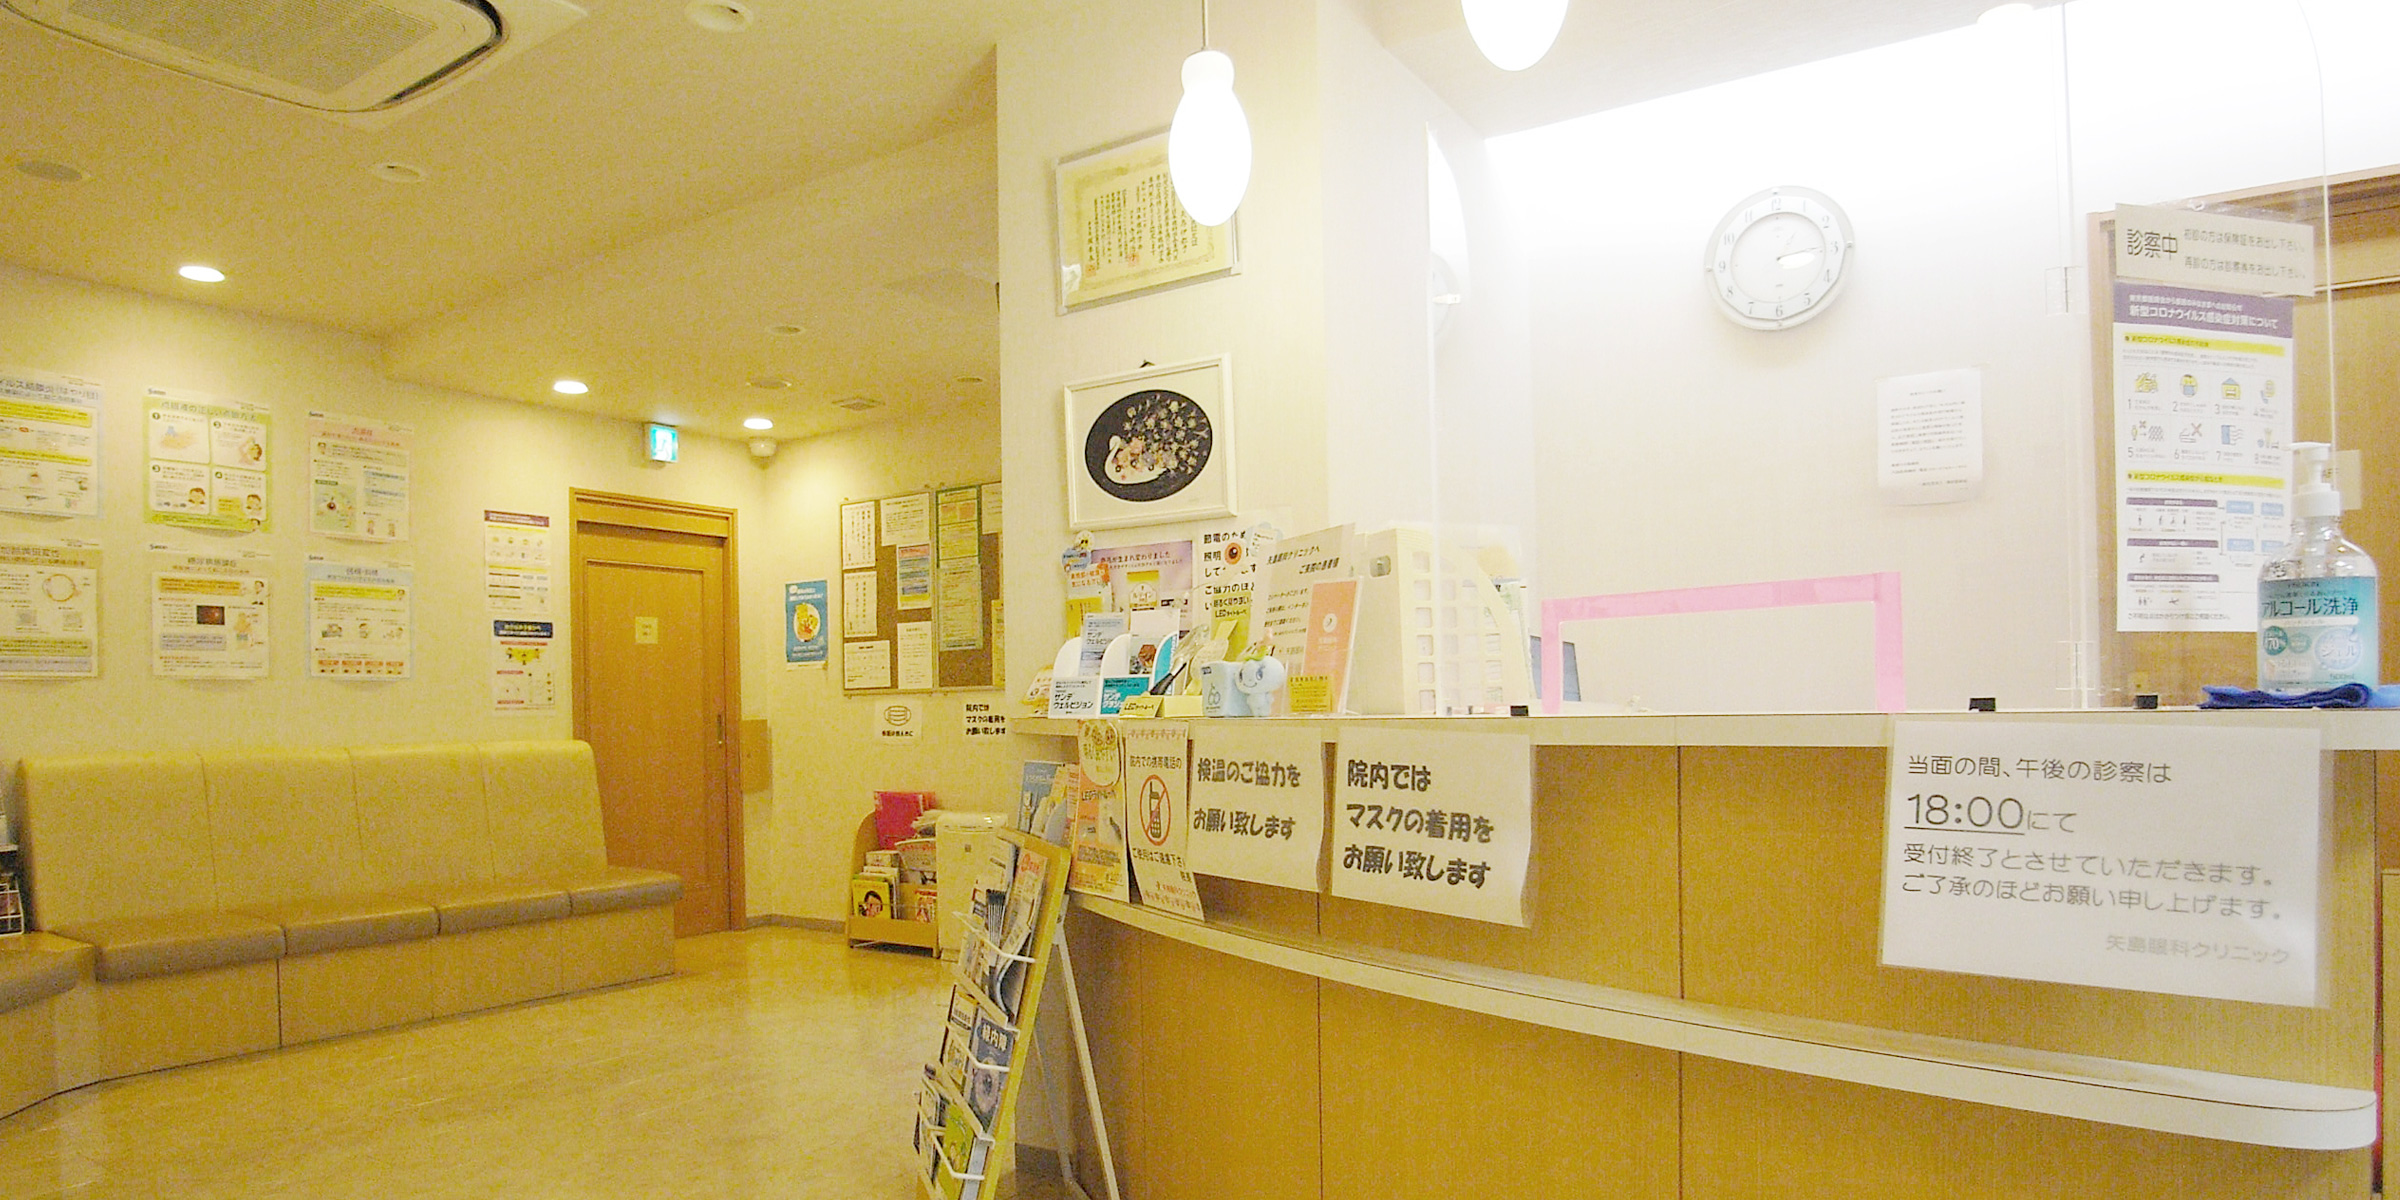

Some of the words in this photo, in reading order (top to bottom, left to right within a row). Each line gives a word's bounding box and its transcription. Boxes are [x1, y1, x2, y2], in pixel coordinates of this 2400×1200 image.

[1822, 216, 1830, 228] 2
[2127, 228, 2178, 260] 診察中
[1775, 305, 1783, 317] 6
[2129, 305, 2278, 329] 新型コロナウイルス感染症対策について
[2261, 597, 2359, 618] アルコール洗浄
[1130, 755, 1182, 770] 院内での携帯電話の
[1197, 757, 1301, 788] 検温のご協力を
[1347, 758, 1431, 793] 院内では
[1908, 754, 2171, 784] 当面の間、午後の診察は
[1193, 807, 1296, 840] お願い致します
[1346, 803, 1494, 843] マスクの着用を
[1343, 843, 1491, 889] お願い致します
[1904, 843, 2273, 887] 受付終了とさせていただきます。
[1902, 873, 2281, 920] ご了承のほどお願い申し上げます。
[2105, 933, 2289, 964] 矢島眼科クリニック
